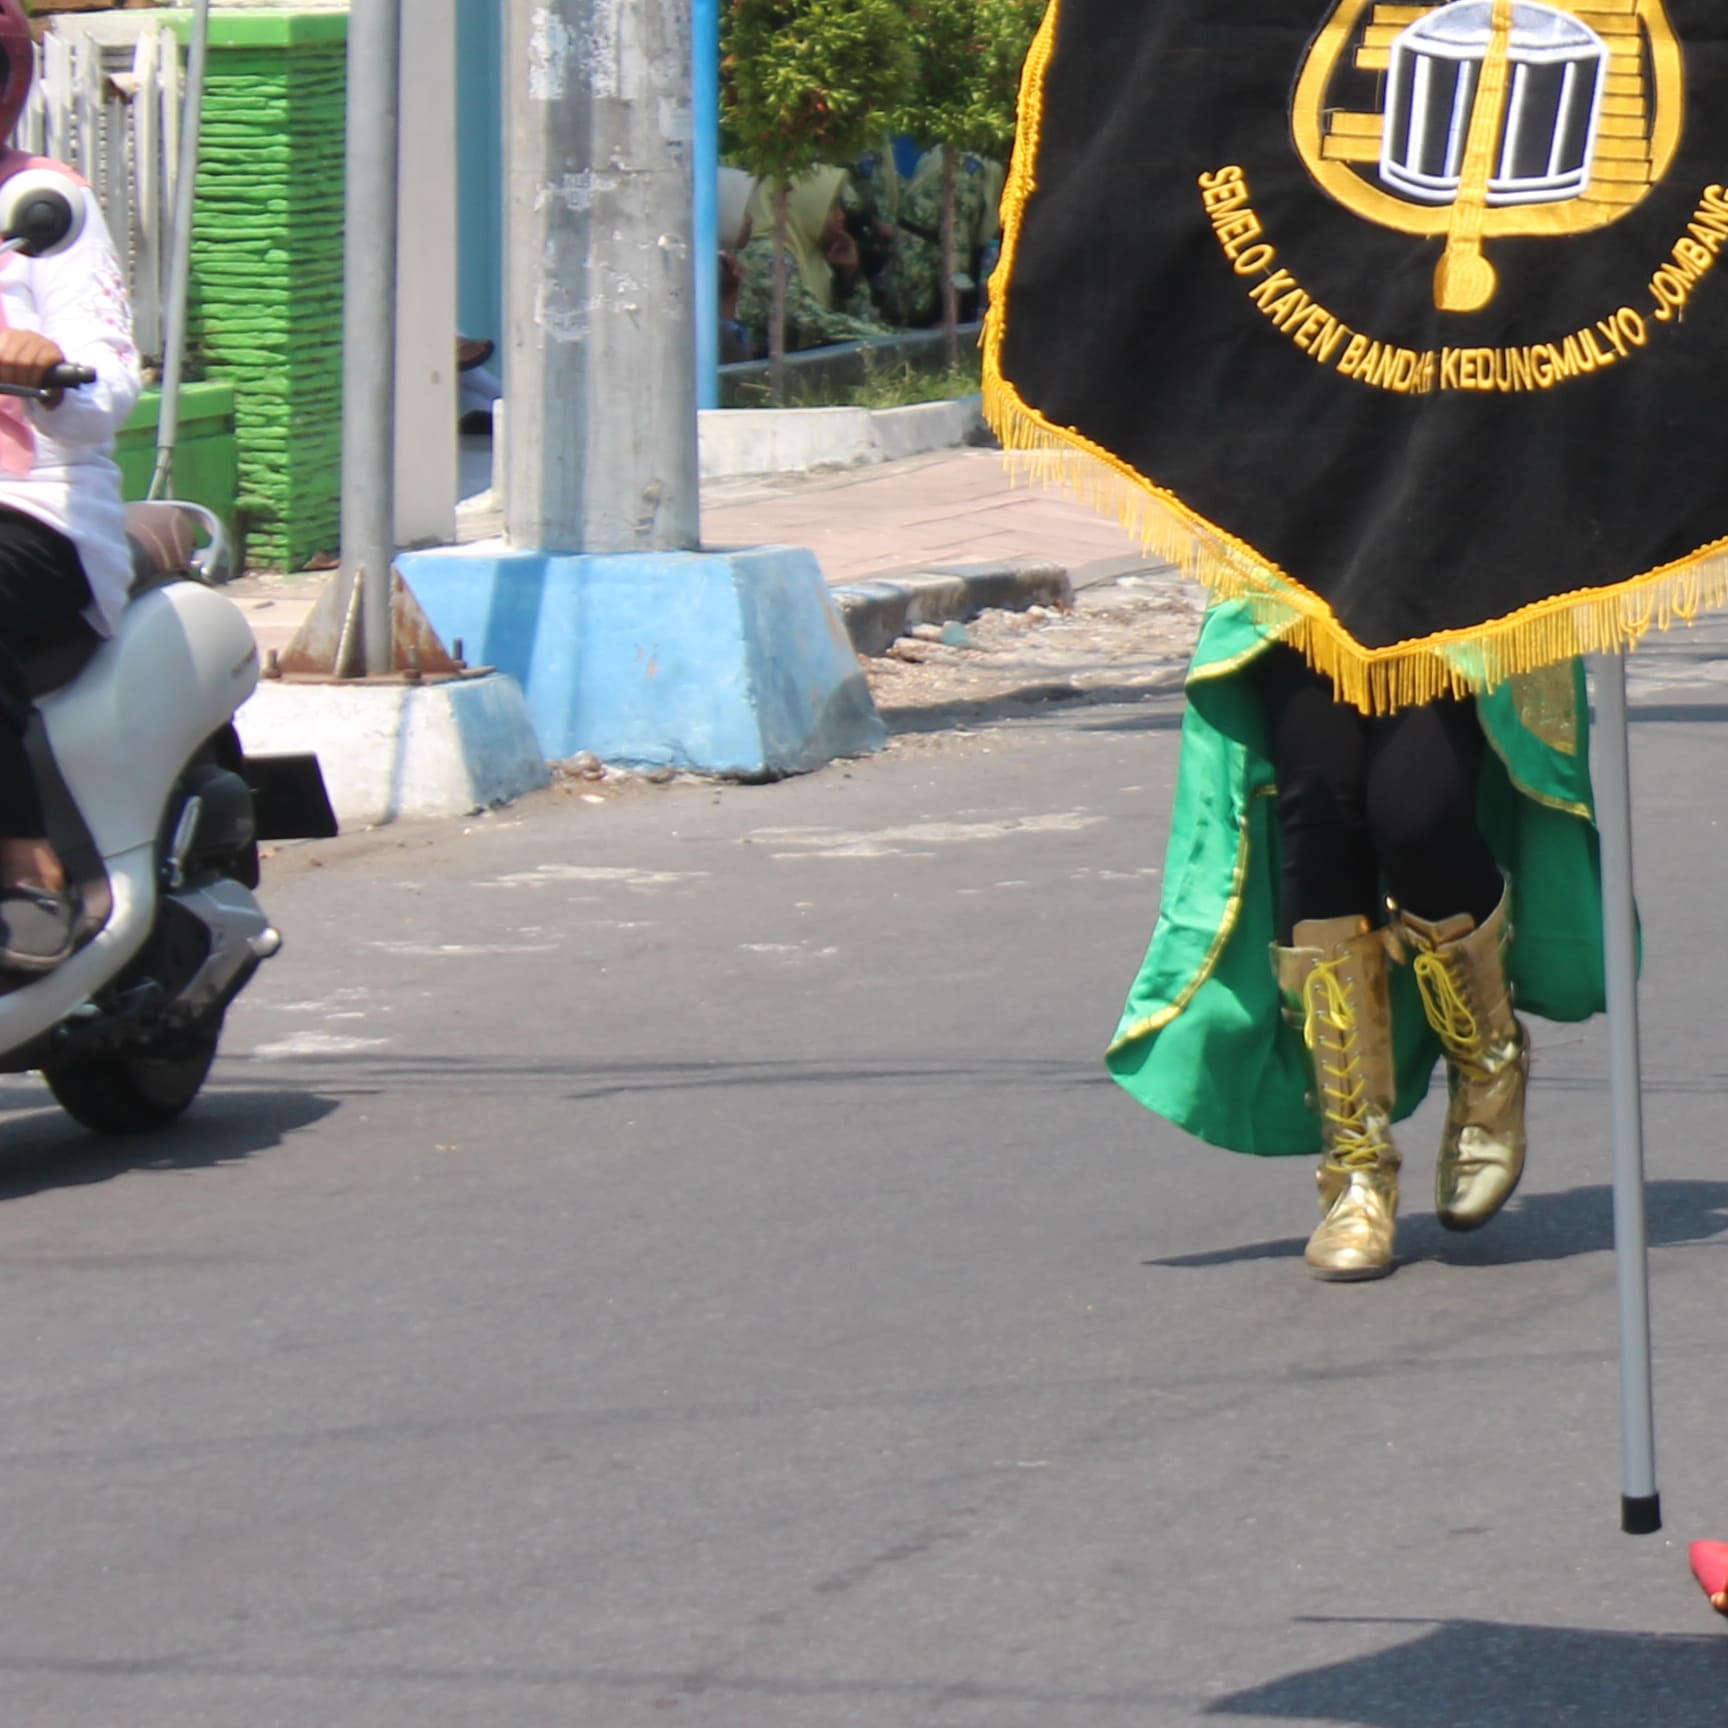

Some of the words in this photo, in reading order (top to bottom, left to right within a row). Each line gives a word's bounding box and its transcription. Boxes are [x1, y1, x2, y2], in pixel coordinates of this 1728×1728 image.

[1198, 164, 1276, 275] SEMELO
[1248, 268, 1348, 363] KAYEN
[1440, 306, 1648, 393] KEDUNGMULYO
